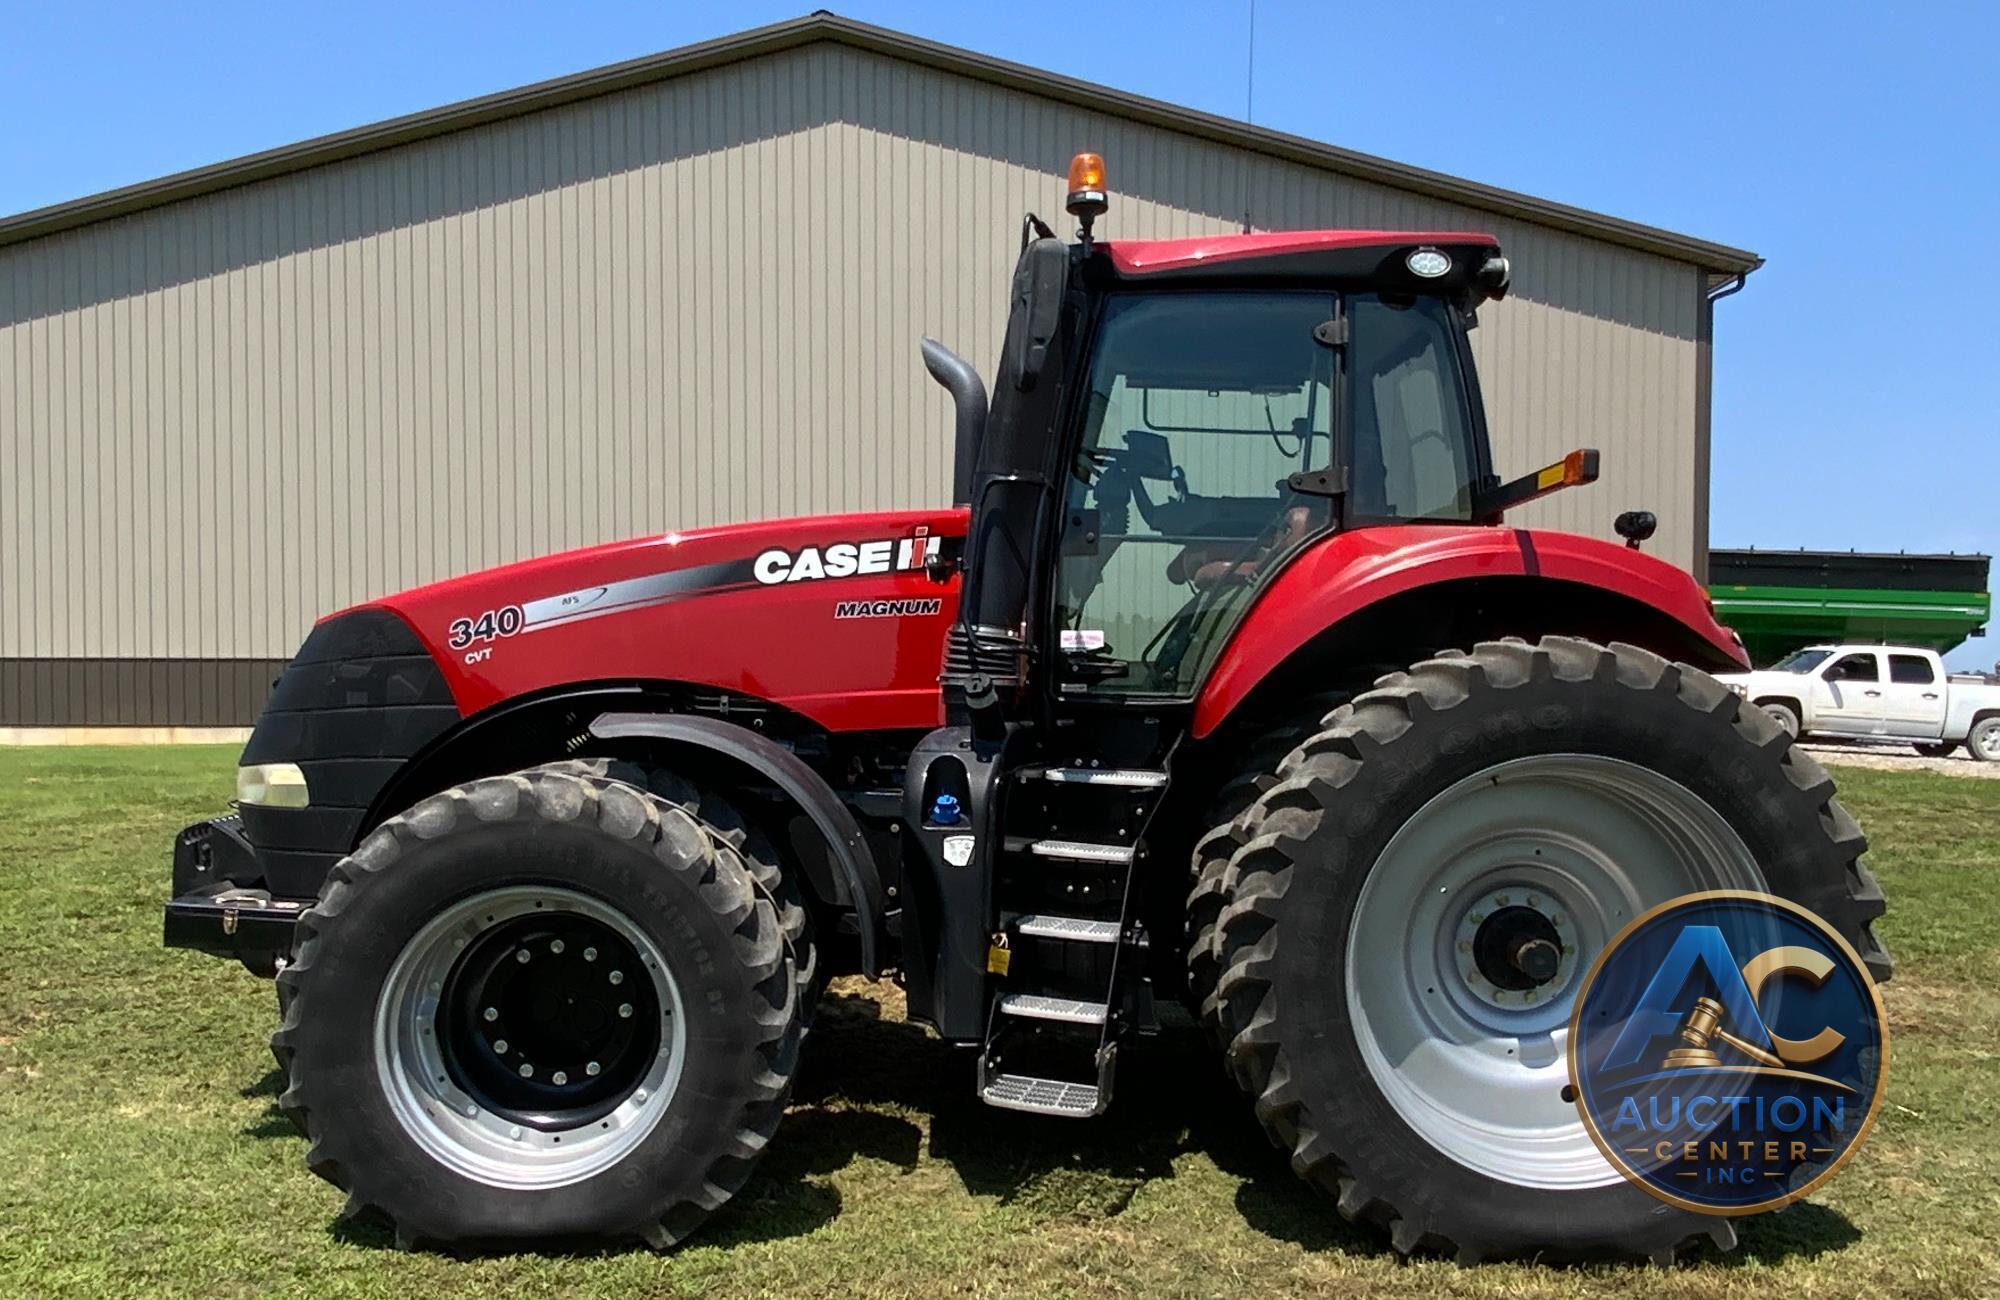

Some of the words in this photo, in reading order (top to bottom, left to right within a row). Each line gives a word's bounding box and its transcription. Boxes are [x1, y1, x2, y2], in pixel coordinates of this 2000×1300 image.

[753, 541, 893, 584] CASE
[834, 598, 942, 619] MAGNUM
[448, 604, 522, 650] 340
[464, 647, 493, 664] CVT
